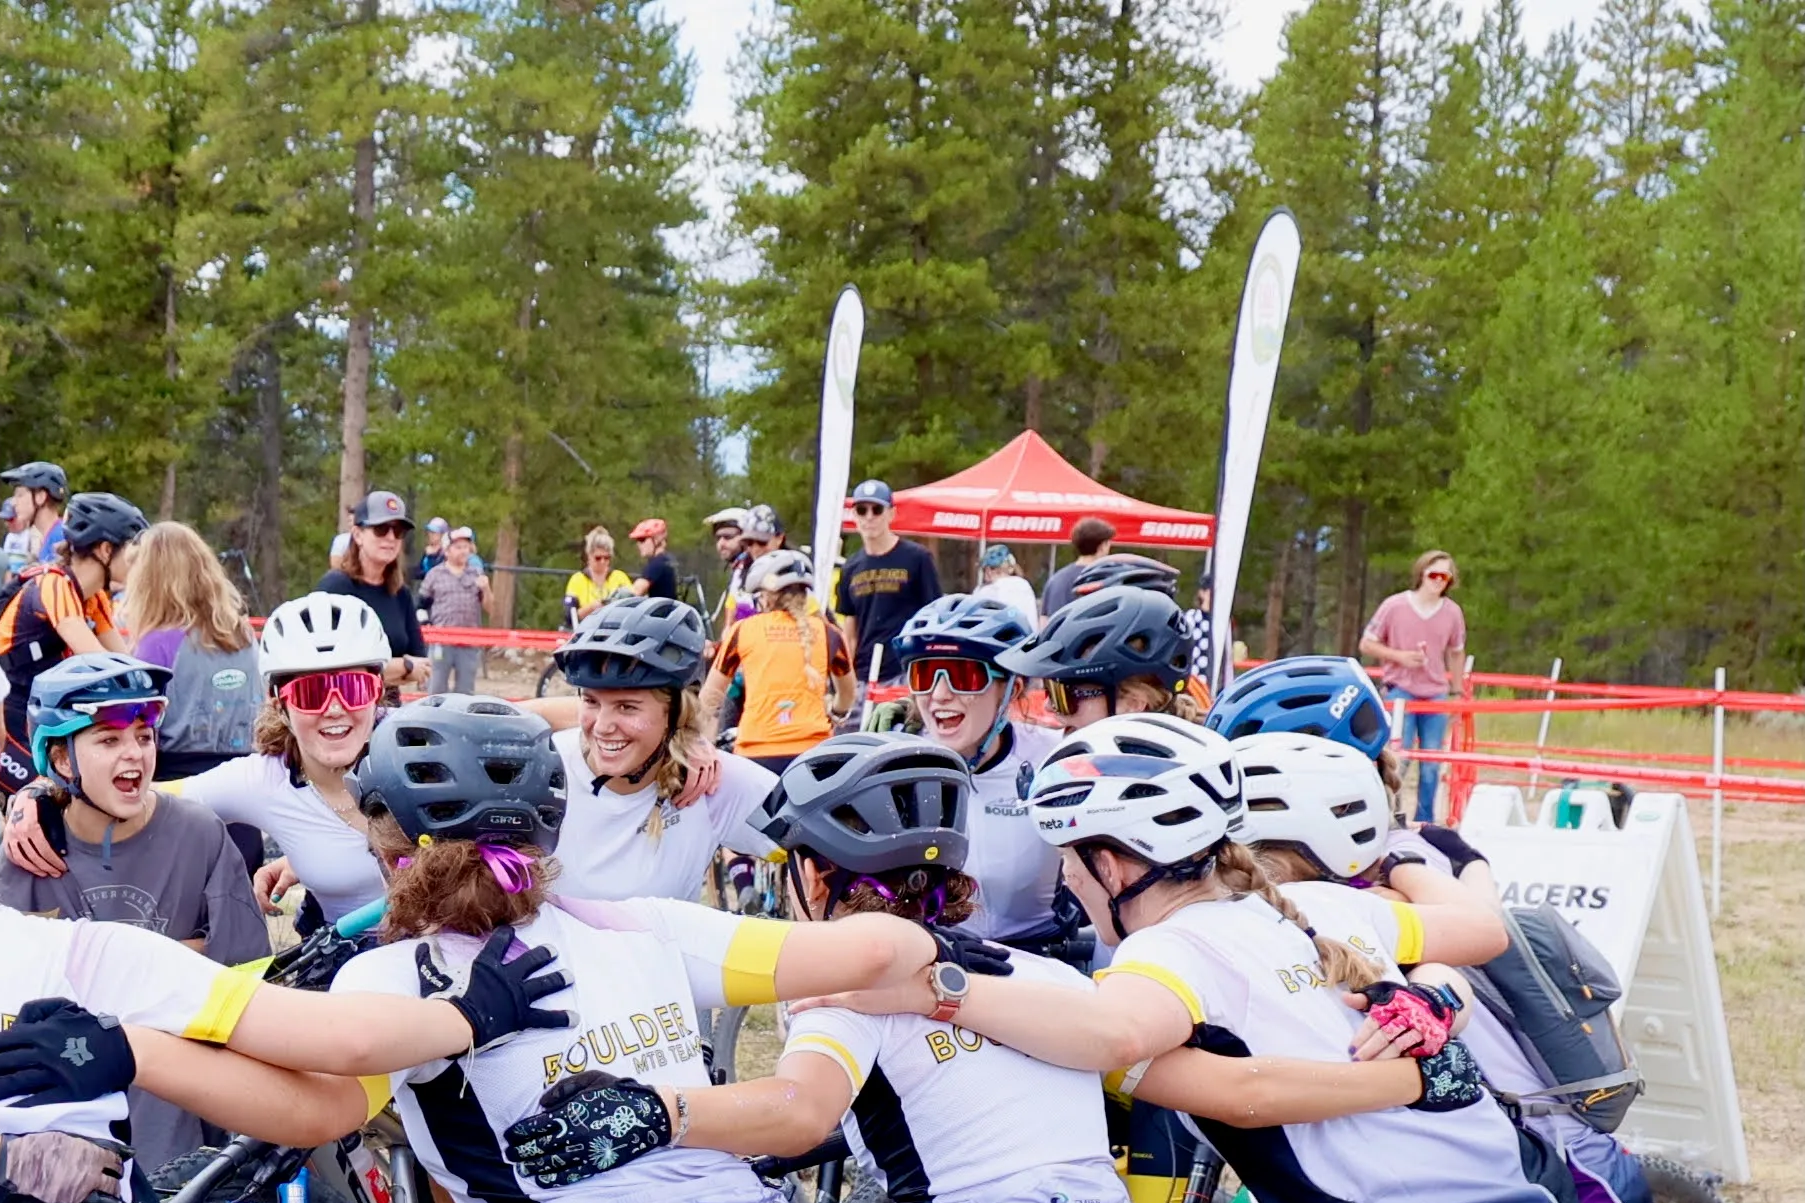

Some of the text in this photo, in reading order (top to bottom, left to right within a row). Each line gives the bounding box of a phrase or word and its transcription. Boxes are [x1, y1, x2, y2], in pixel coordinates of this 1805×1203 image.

[931, 511, 981, 529] SRAM
[991, 514, 1062, 532] SRAM
[1139, 521, 1209, 539] SRAM
[1039, 817, 1064, 830] meta
[1494, 881, 1610, 909] ACERS
[543, 1002, 694, 1085] BOULDER
[632, 1050, 668, 1075] MTB
